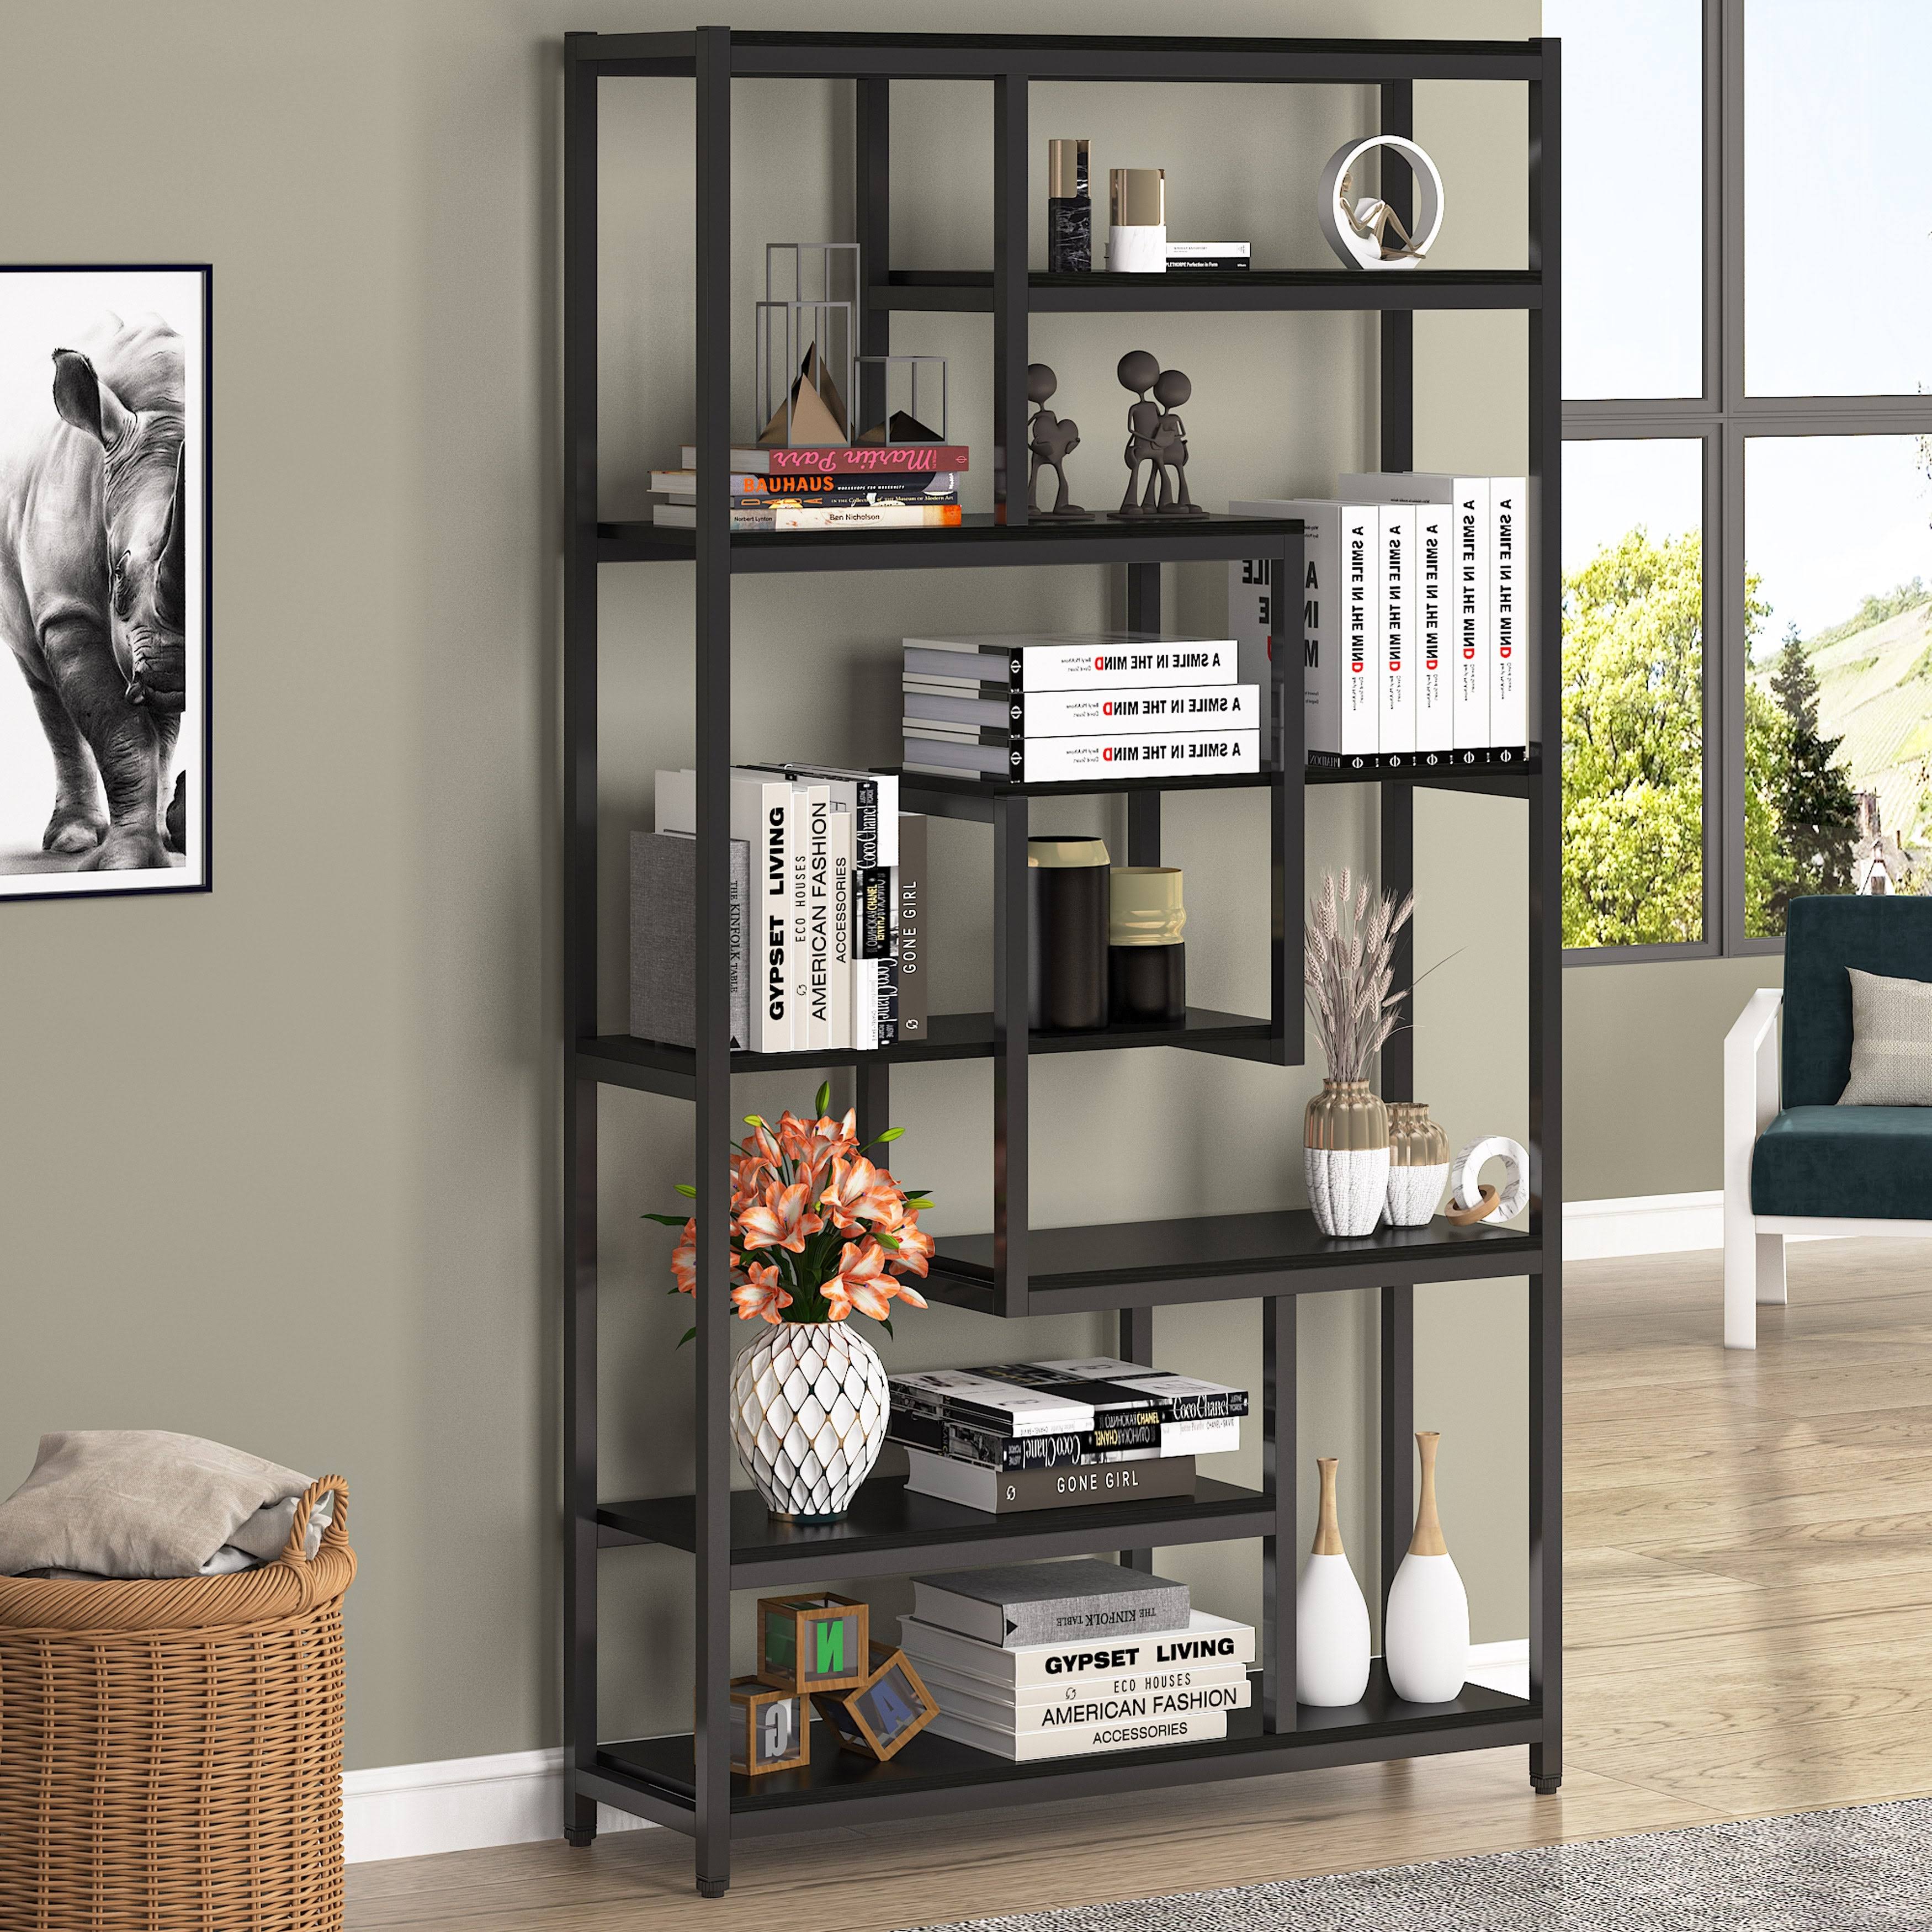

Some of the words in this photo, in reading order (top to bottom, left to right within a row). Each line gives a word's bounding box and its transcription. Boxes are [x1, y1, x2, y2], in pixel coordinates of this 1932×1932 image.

[773, 451, 837, 472] Parr
[843, 450, 932, 470] Martin
[744, 476, 834, 492] BAUHAUS
[769, 808, 784, 895] LIVING
[812, 803, 826, 897] FASHION
[795, 856, 805, 907] HOUSES
[867, 884, 878, 911] CHANEL
[903, 882, 916, 918] GIRL
[836, 858, 846, 963] ACCESSORIES
[731, 904, 741, 960] KINFOLK
[795, 919, 805, 942] ECO
[903, 928, 916, 973] GONE
[769, 915, 784, 1021] GYPSET
[812, 906, 826, 1021] AMERICAN
[1137, 1411, 1160, 1425] CHANEL
[1095, 1430, 1118, 1446] CHANEL
[1057, 1474, 1097, 1493] GONE
[1106, 1469, 1139, 1488] GIRL
[1057, 1616, 1084, 1627] TABLE
[1085, 1609, 1137, 1626] KINFOLK
[1139, 1607, 1156, 1618] THE
[1045, 1648, 1139, 1675] GYPSET
[1156, 1637, 1234, 1662] LIVING
[1114, 1679, 1136, 1693] ECO
[1145, 1673, 1192, 1690] HOUSES
[1042, 1697, 1145, 1727] AMERICAN
[1153, 1687, 1236, 1713] FASHION
[1093, 1722, 1188, 1744] ACCESSORIES
